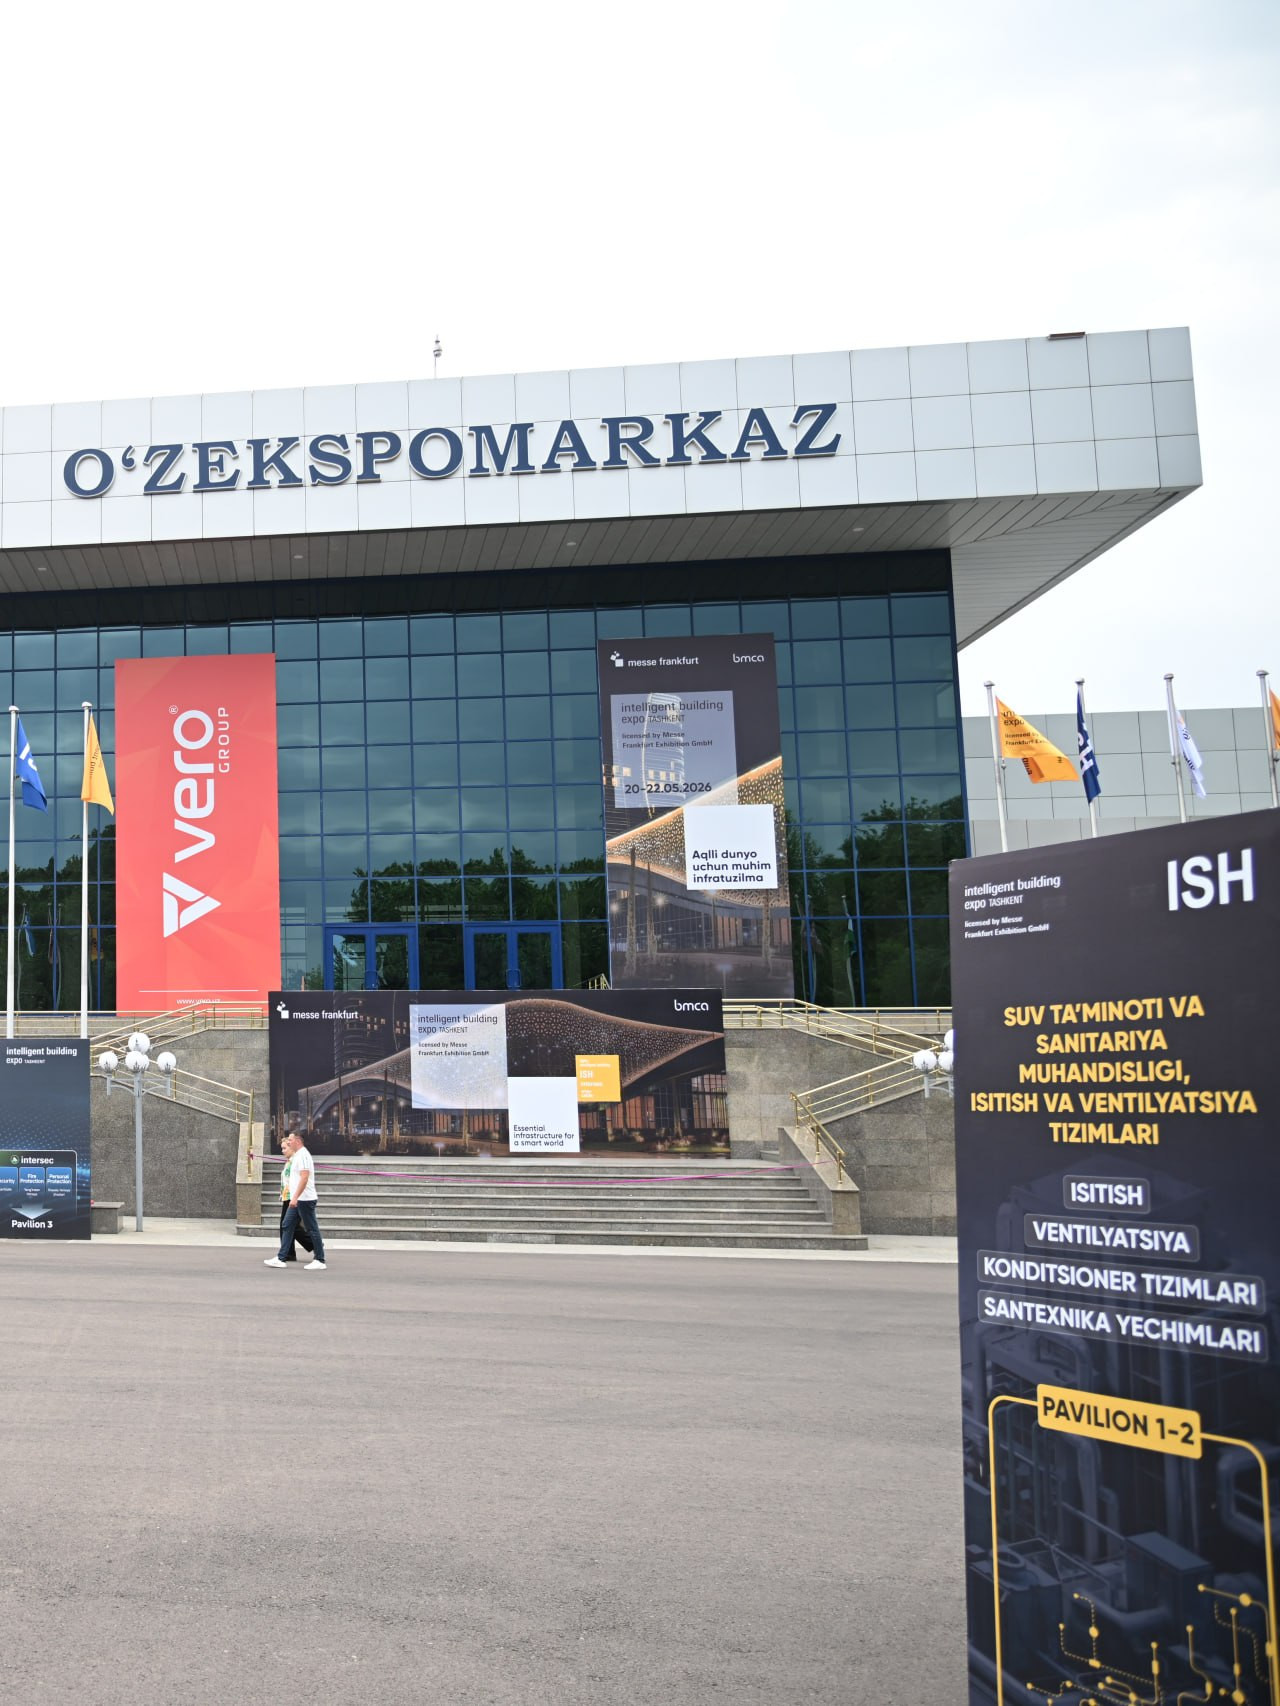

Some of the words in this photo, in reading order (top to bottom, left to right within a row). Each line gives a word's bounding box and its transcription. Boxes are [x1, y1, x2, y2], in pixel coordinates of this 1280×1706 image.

[628, 658, 656, 667] messe
[659, 657, 699, 666] frankfurt
[732, 653, 765, 663] bmca
[621, 702, 675, 714] intelligent
[679, 700, 723, 712] building
[621, 715, 645, 725] expo
[648, 714, 685, 724] TASHKENT
[217, 707, 230, 773] GROUP
[652, 732, 660, 740] by
[655, 740, 690, 748] Exhibition
[691, 739, 713, 747] GmbH
[692, 849, 718, 861] Aqlli
[721, 849, 757, 861] dunyo
[692, 862, 729, 871] uchun
[731, 861, 771, 871] muhim
[693, 873, 763, 883] infratuzilma
[1167, 848, 1254, 911] ISH
[964, 881, 1014, 897] intelligent
[1017, 875, 1061, 891] building
[964, 899, 986, 911] expo
[989, 895, 1023, 907] TASHKENT
[964, 918, 990, 928] licensed
[992, 917, 1000, 926] by
[1001, 915, 1023, 924] Messe
[964, 930, 993, 939] Frankfurt
[995, 926, 1027, 936] Exhibition
[1028, 924, 1049, 933] GmbH
[674, 999, 709, 1012] bmca
[1004, 1005, 1045, 1027] SUV
[1169, 995, 1205, 1018] VA
[292, 1011, 320, 1020] messe
[321, 1010, 359, 1019] frankfurt
[417, 1014, 460, 1025] intelligent
[463, 1014, 498, 1024] building
[418, 1026, 437, 1034] expo
[441, 1041, 449, 1049] by
[1036, 1029, 1168, 1054] SANITARIYA
[6, 1047, 44, 1057] intelligent
[46, 1047, 78, 1056] building
[6, 1057, 23, 1065] expo
[1019, 1059, 1190, 1085] MUHANDISLIGI,
[970, 1092, 1038, 1112] ISITISH
[1043, 1092, 1075, 1113] VA
[1078, 1090, 1258, 1114] VENTILYATSIYA
[1048, 1122, 1159, 1145] TIZIMLARI
[21, 1156, 54, 1164] intersec
[1070, 1182, 1143, 1206] ISITISH
[11, 1220, 46, 1228] Pavilion
[1033, 1220, 1190, 1254] VENTILYATSIYA
[983, 1256, 1136, 1292] KONDITSIONER
[1141, 1273, 1257, 1306] TIZIMLARI
[984, 1296, 1111, 1333] SANTEXNIKA
[1116, 1314, 1260, 1353] YECHIMLARI
[1042, 1396, 1148, 1437] PAVILION
[1156, 1417, 1195, 1446] 1-2
